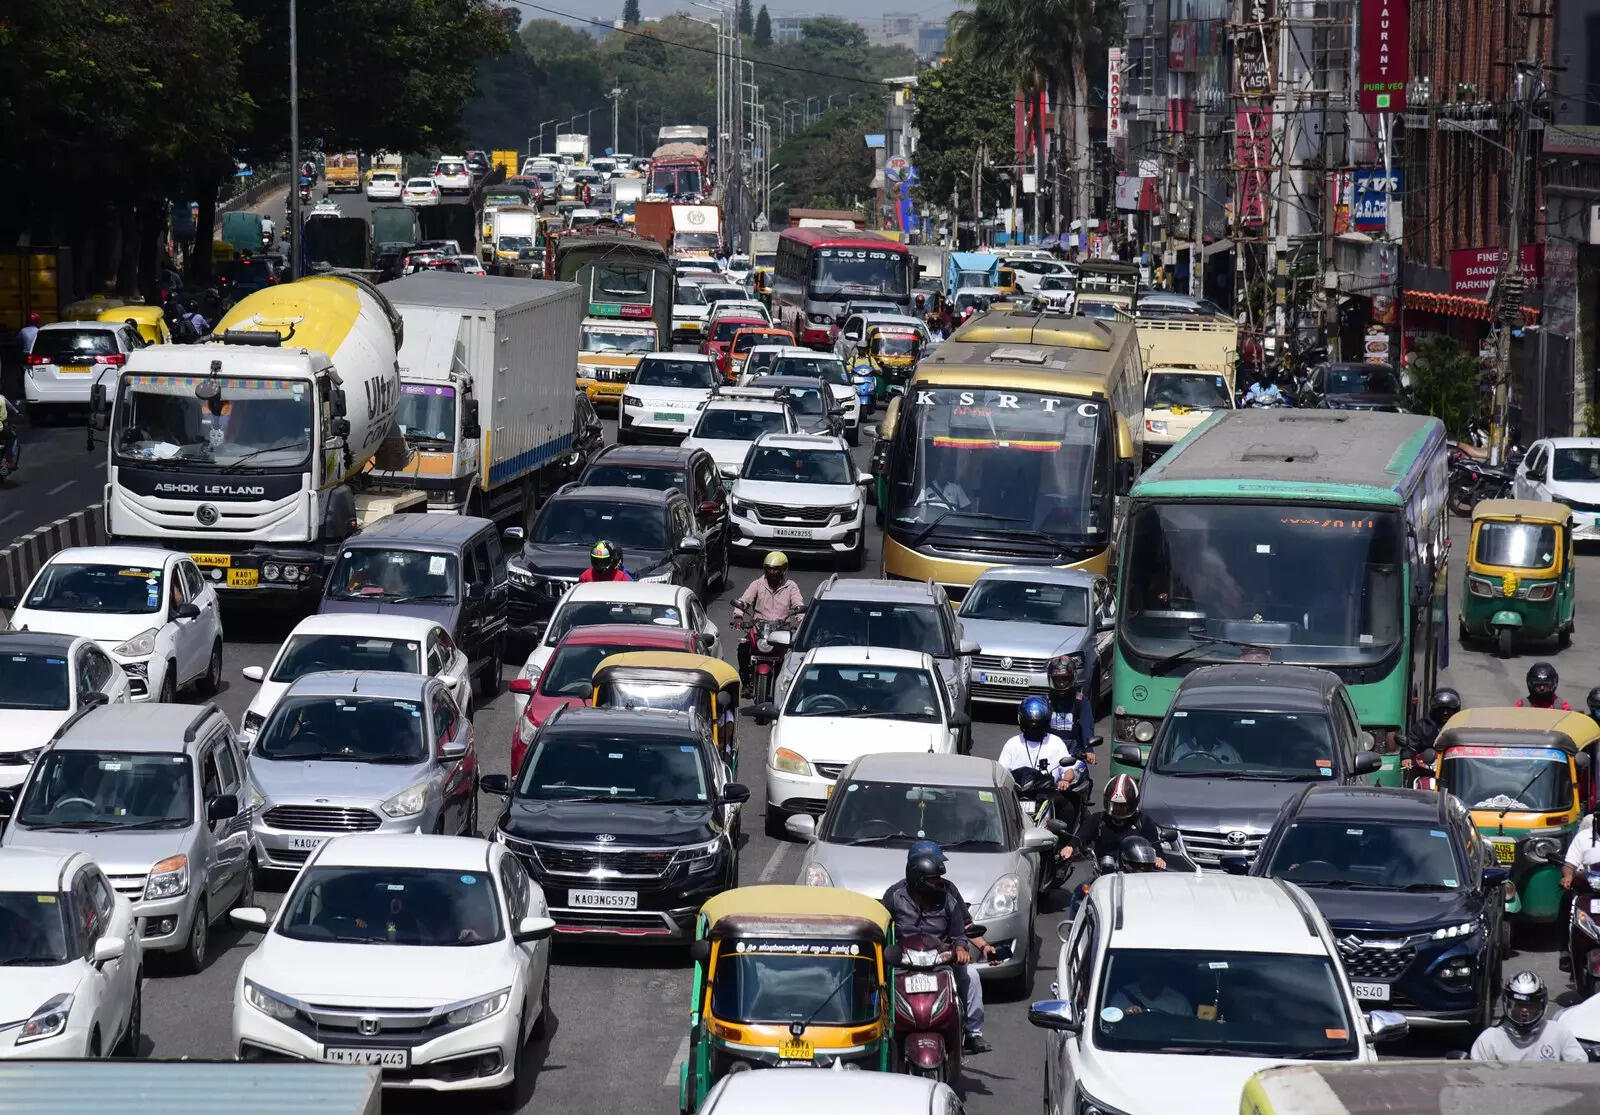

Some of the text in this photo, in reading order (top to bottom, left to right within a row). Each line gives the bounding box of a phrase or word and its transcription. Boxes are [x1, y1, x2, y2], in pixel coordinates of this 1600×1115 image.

[1243, 62, 1269, 73] PUNJA
[1363, 82, 1404, 91] PURE VEG
[1111, 74, 1119, 129] ROOMS
[1358, 177, 1399, 192] TVS
[1477, 252, 1499, 262] FINE
[154, 483, 265, 495] ASHOK LEYLAND
[575, 894, 636, 906] KA03NG5979
[1352, 985, 1383, 998] 6540
